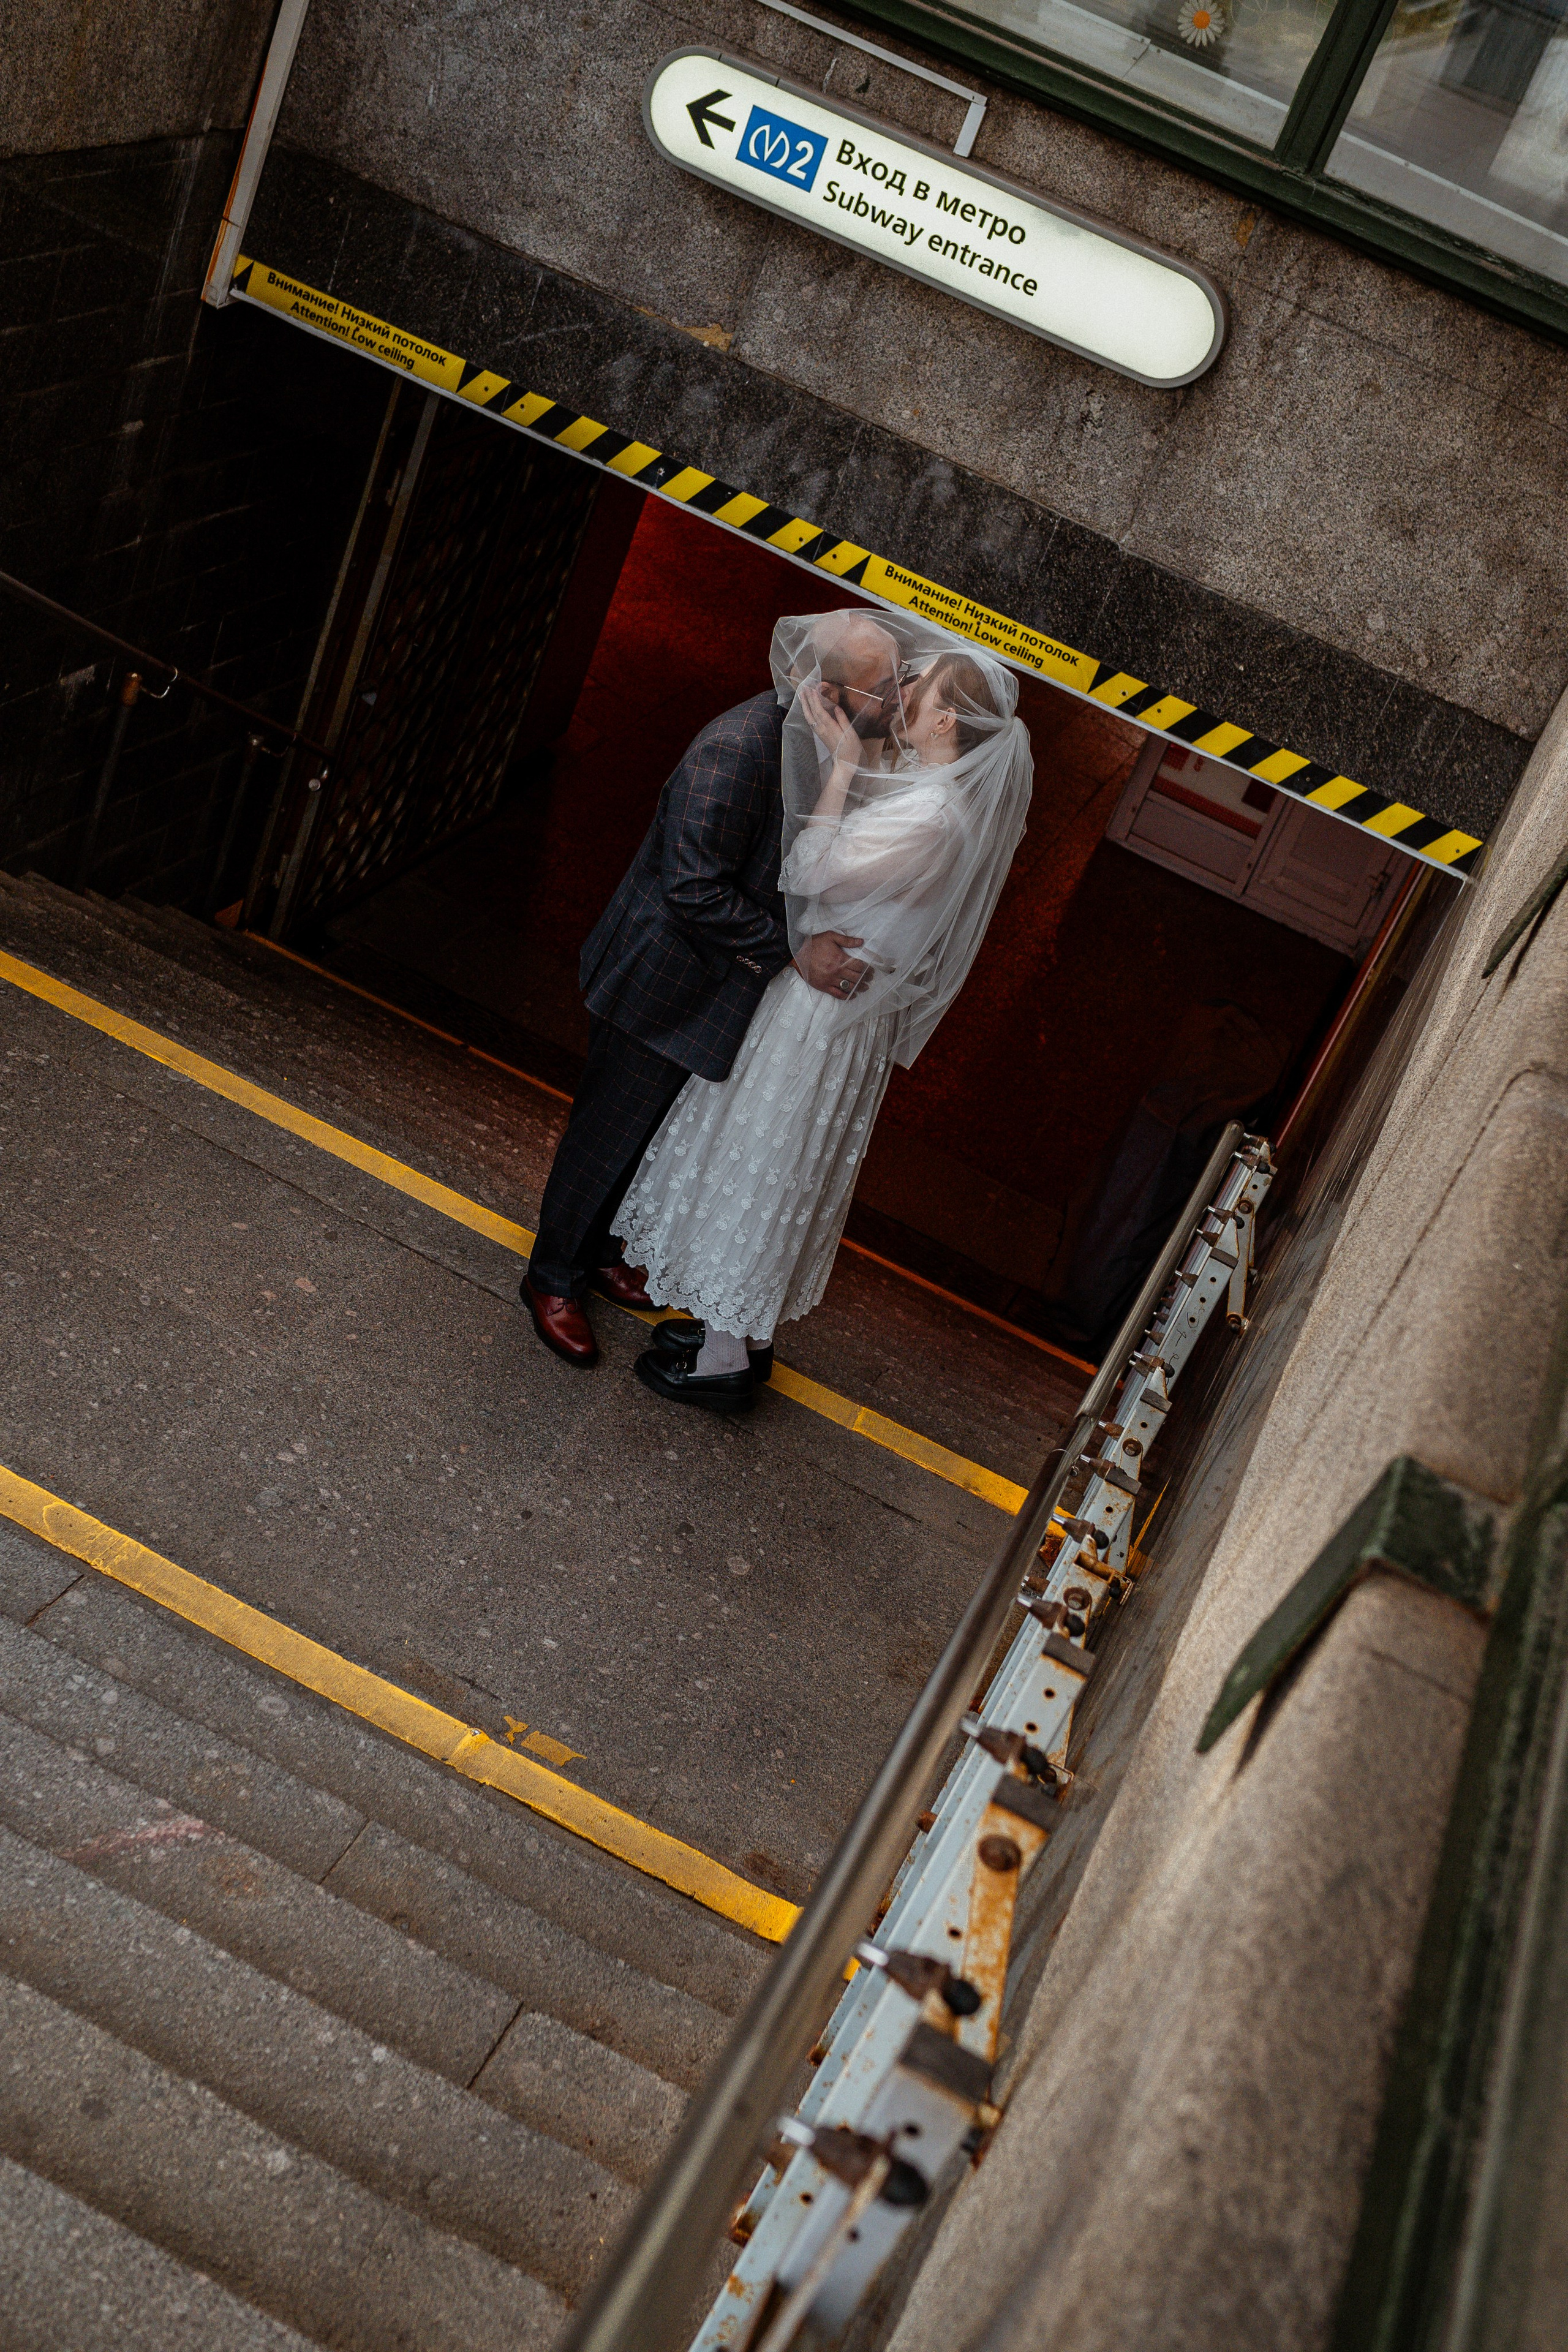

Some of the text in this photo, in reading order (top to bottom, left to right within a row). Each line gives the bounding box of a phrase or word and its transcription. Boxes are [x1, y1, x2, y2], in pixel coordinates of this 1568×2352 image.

[823, 181, 1038, 296] Subway entrance
[835, 139, 1026, 244] Вход в метро
[267, 271, 447, 366] Внимание! Низкий потолок
[290, 301, 415, 370] Attention! Low ceiling
[884, 565, 1079, 666] Внимание! Низкий потолок
[908, 595, 1044, 669] Attention! Low ceiling
